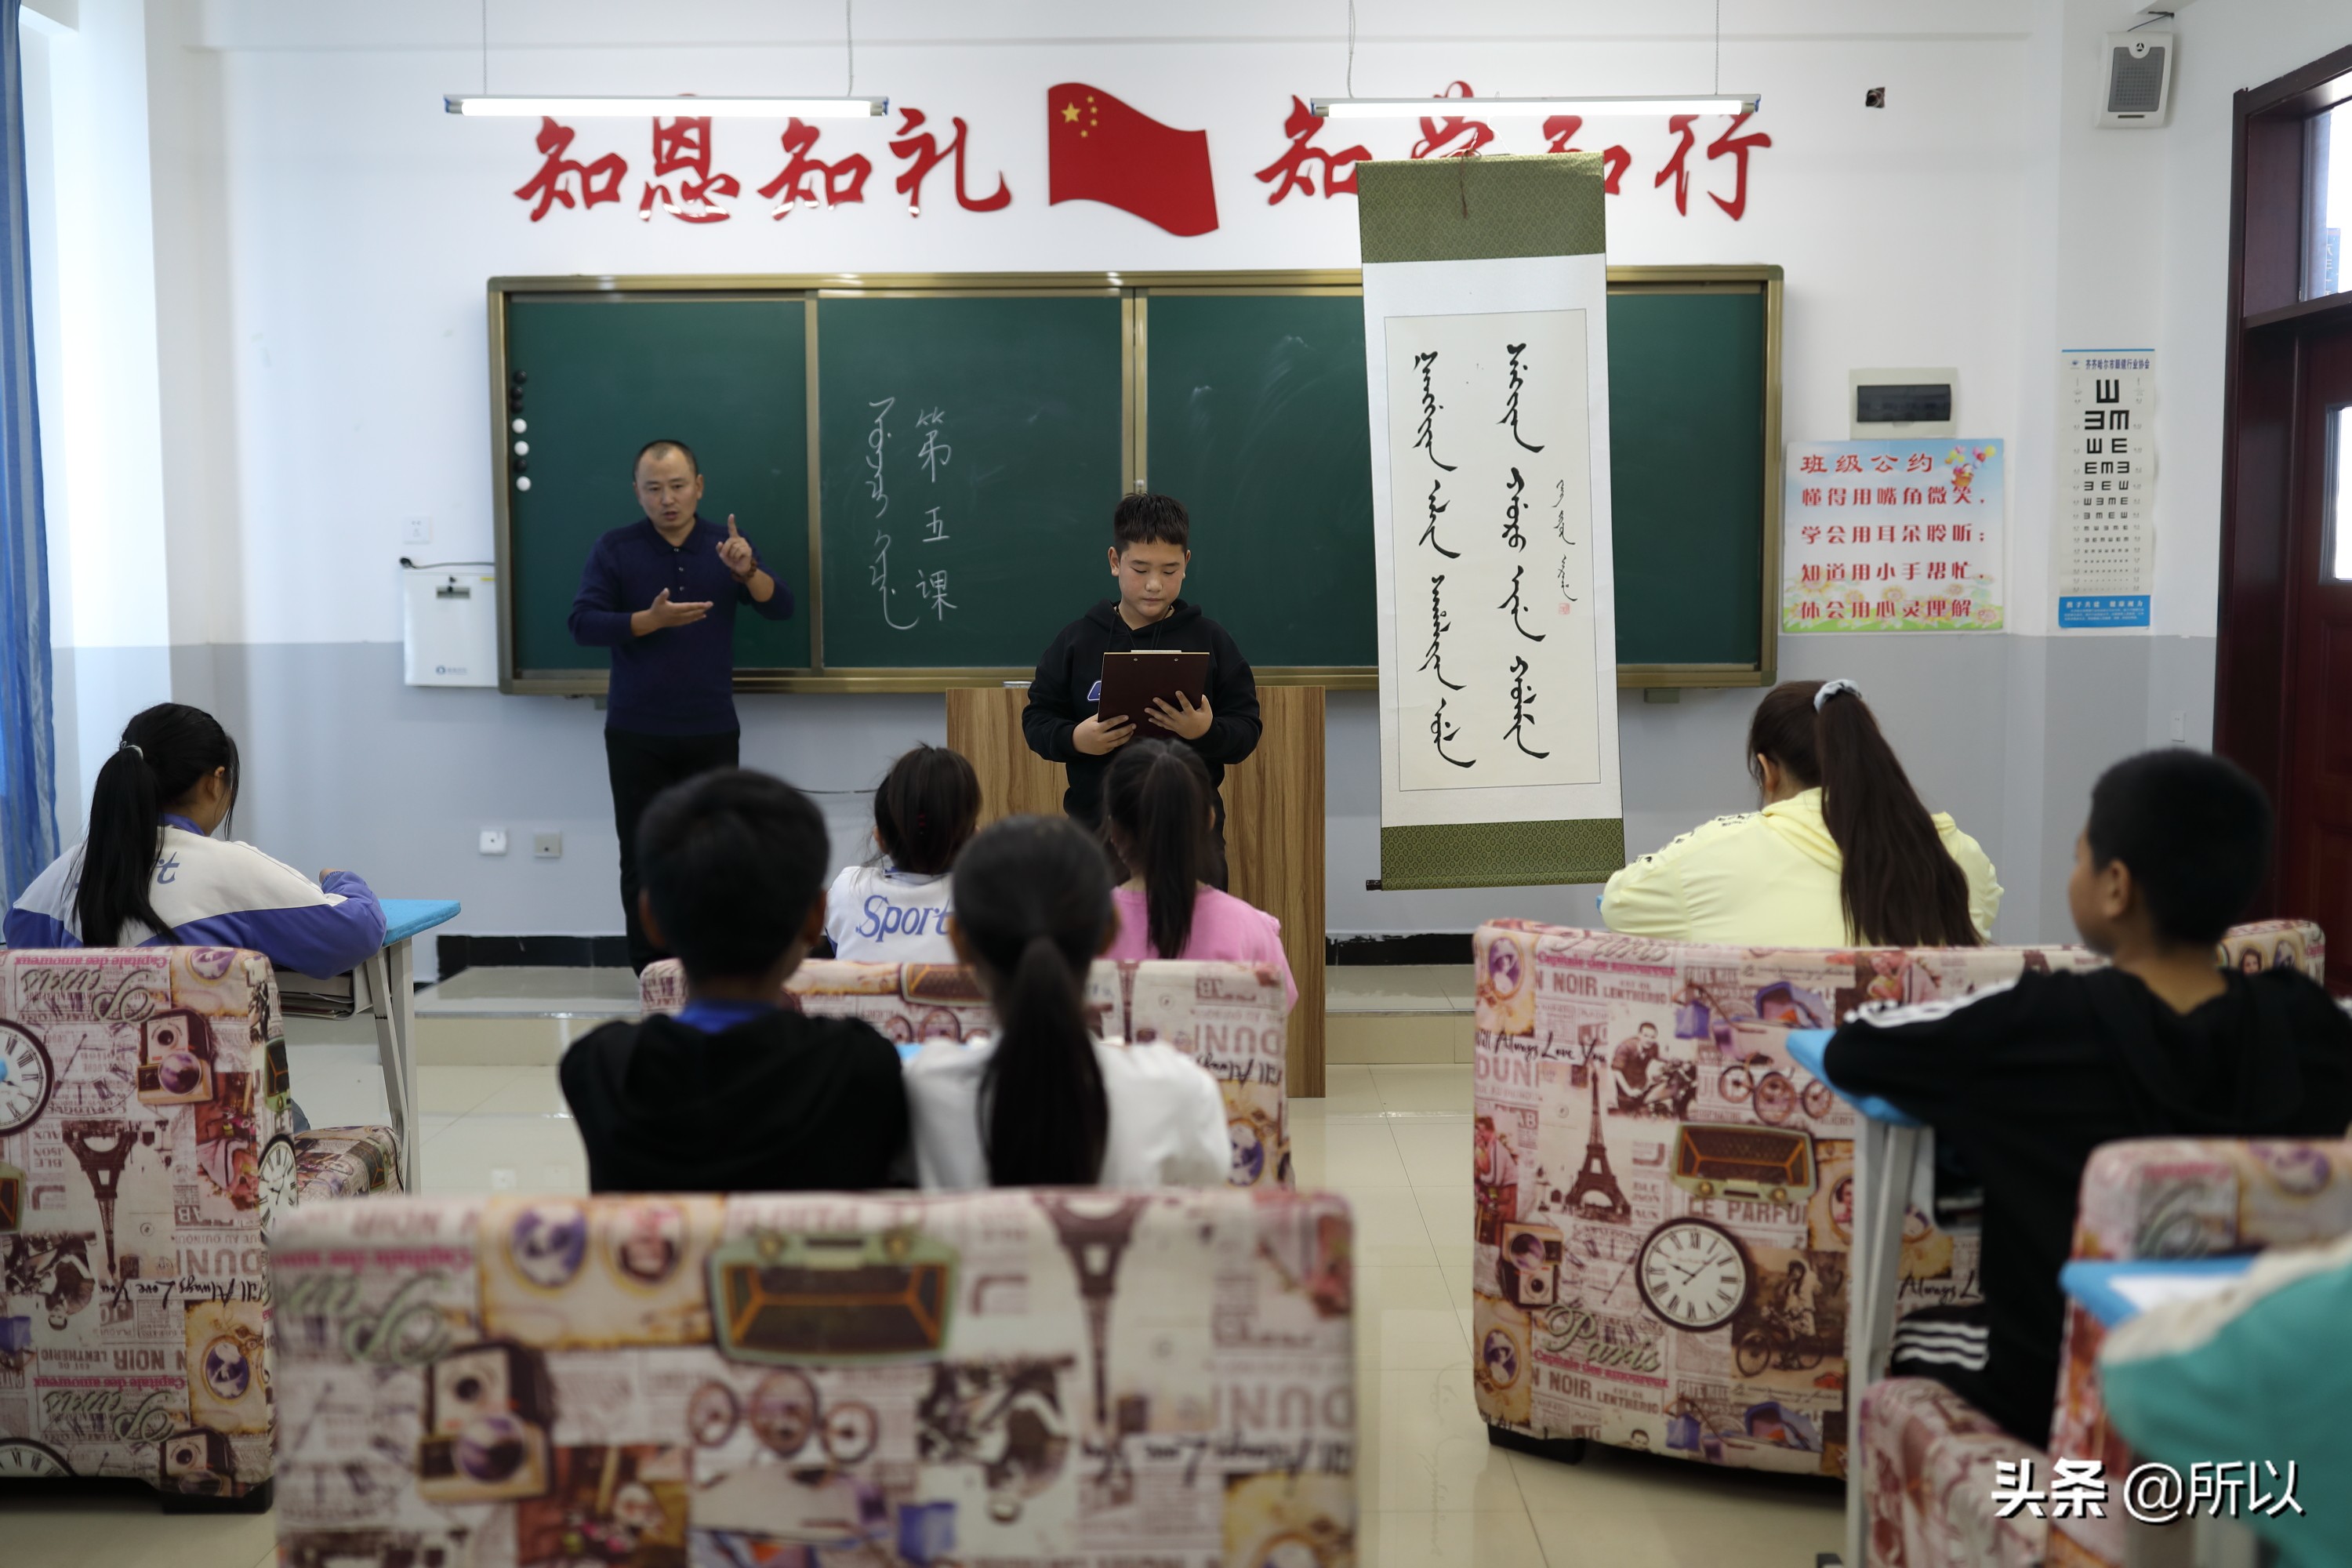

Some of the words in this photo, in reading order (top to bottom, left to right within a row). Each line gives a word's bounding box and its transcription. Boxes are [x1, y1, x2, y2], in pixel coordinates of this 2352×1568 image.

[514, 94, 1012, 223] 知恩知礼
[1800, 453, 1933, 474] 班级公约
[915, 406, 958, 621] 第五课
[1553, 972, 1599, 997] NOIR
[1494, 1025, 1538, 1062] Always
[1541, 1031, 1575, 1062] Love
[100, 1278, 130, 1308] You
[135, 1279, 176, 1310] Love
[179, 1274, 235, 1308] Always
[1544, 1304, 1661, 1372] Paris
[113, 1349, 165, 1370] NOIR
[1548, 1372, 1592, 1400] NOIR
